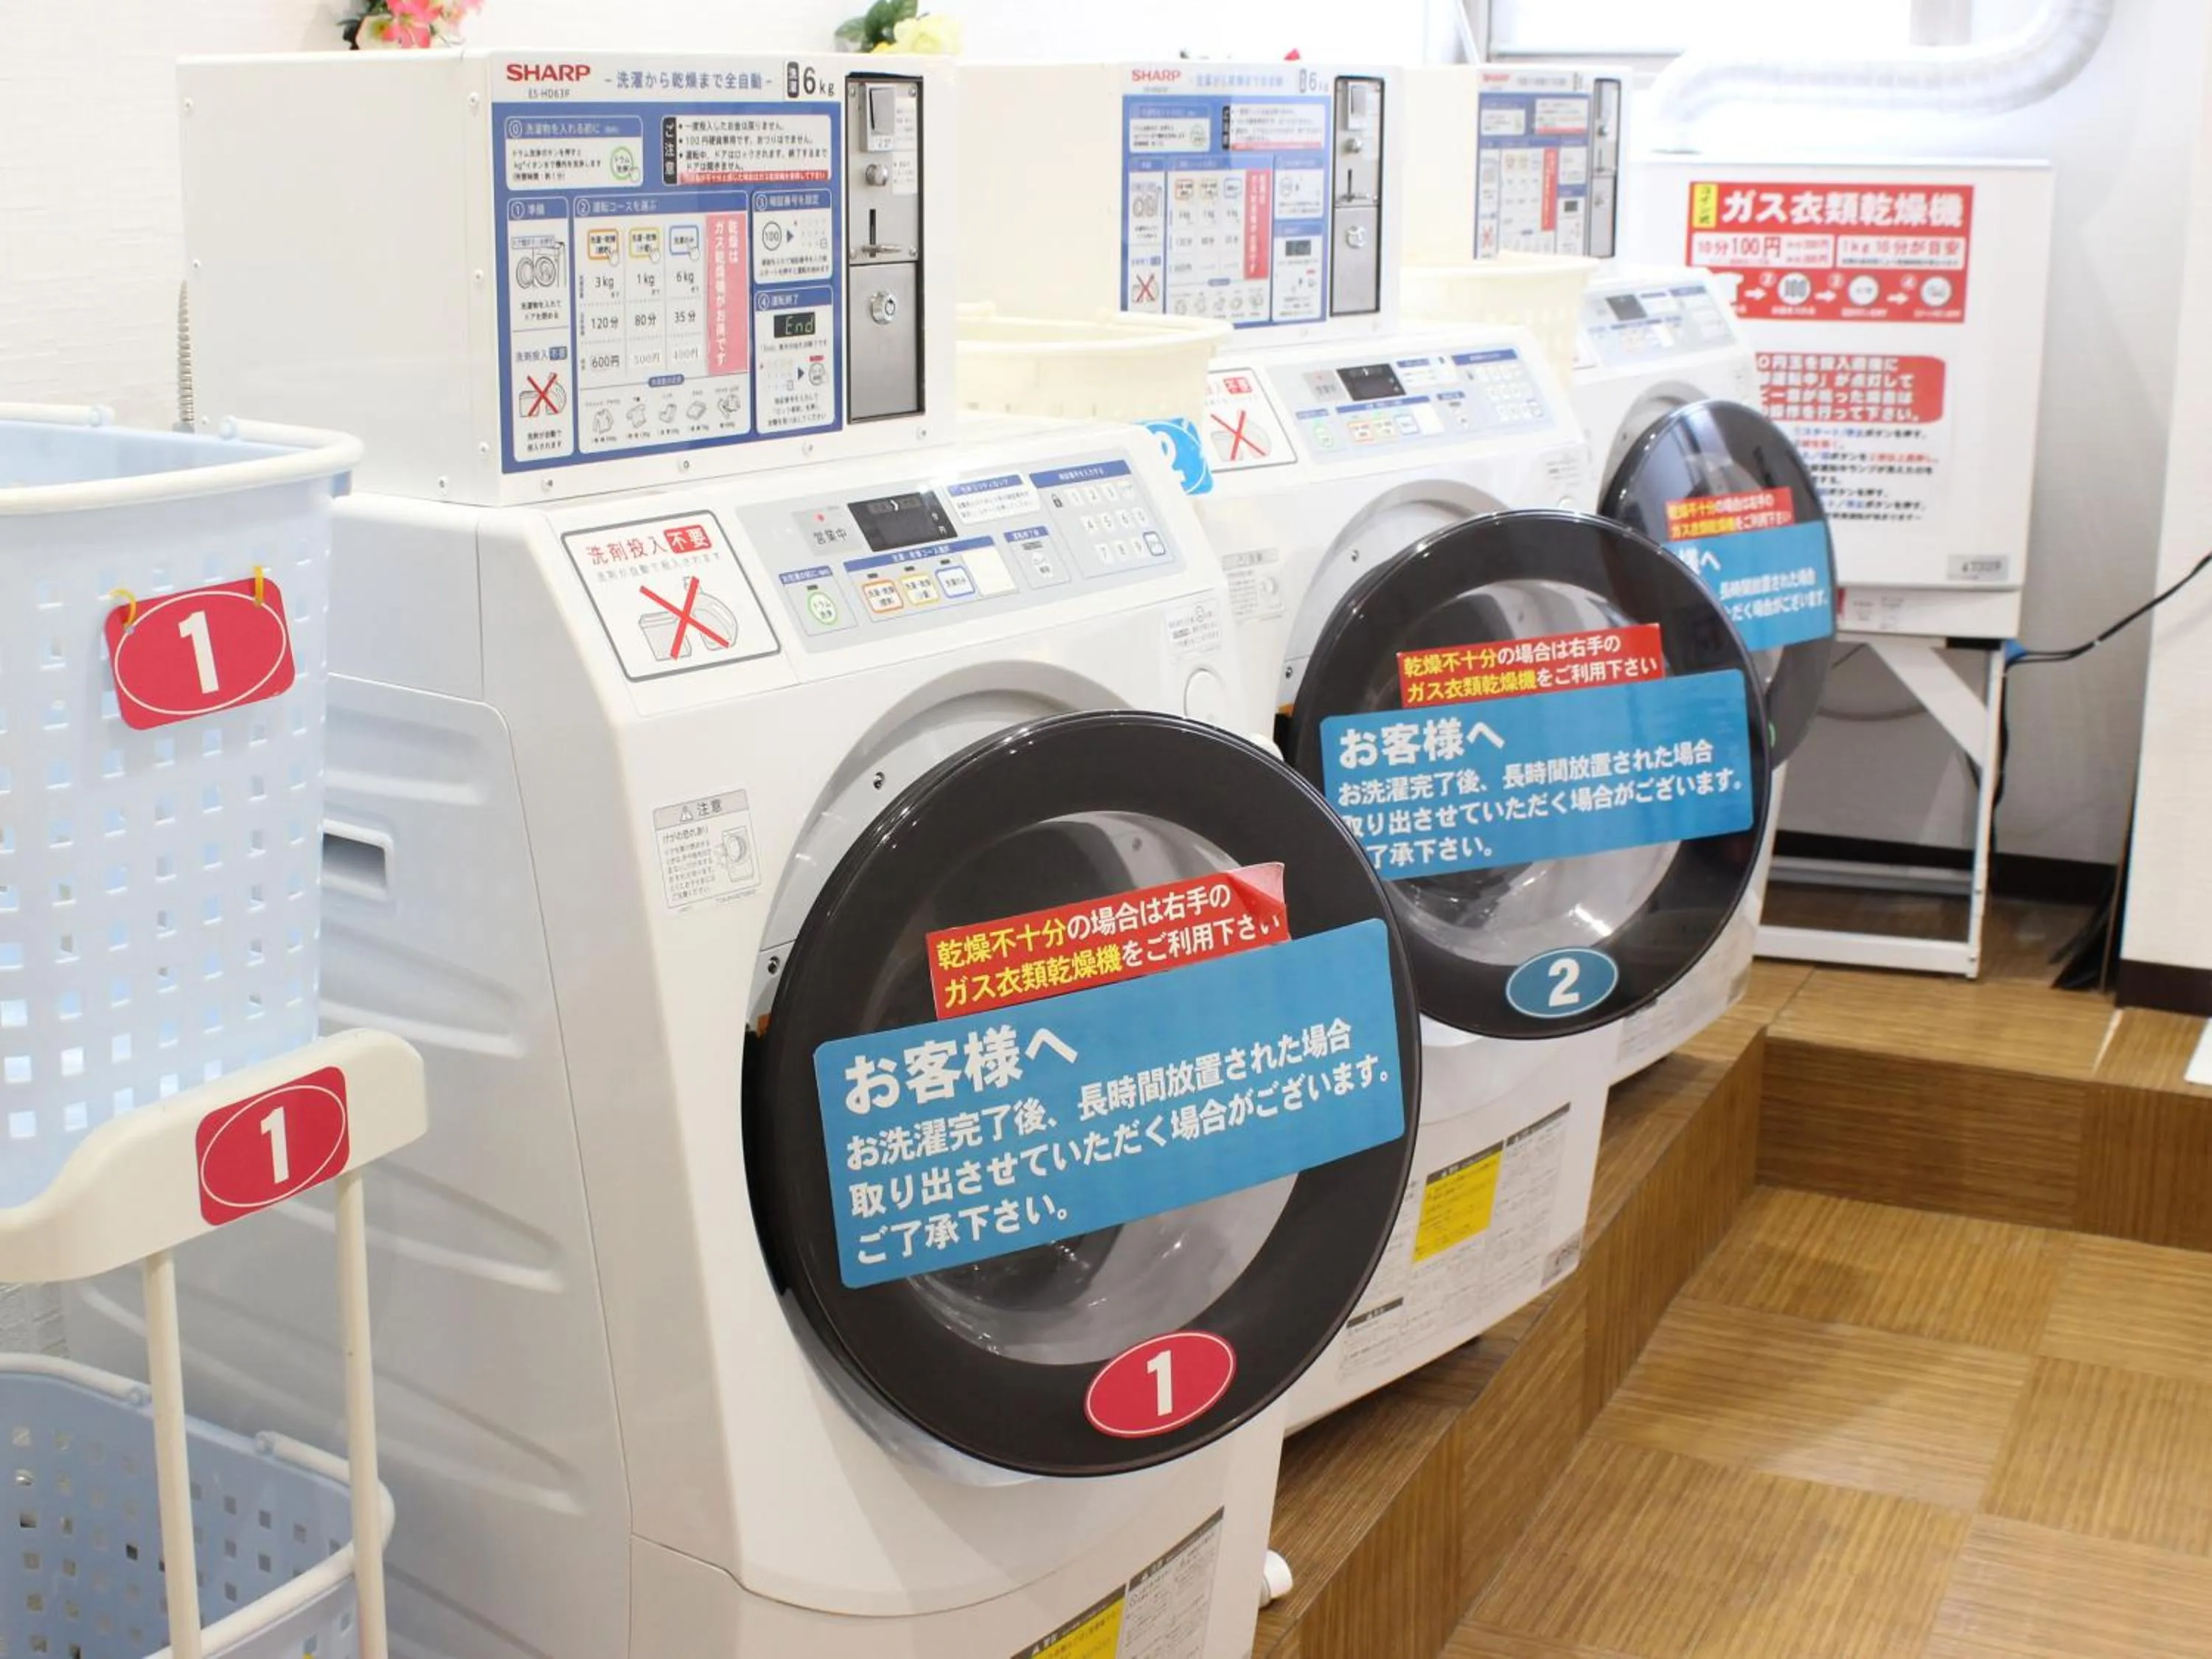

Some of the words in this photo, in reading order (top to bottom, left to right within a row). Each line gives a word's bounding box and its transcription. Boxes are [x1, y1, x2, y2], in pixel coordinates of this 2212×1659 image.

[507, 64, 591, 82] SHARP
[804, 67, 835, 96] 6kg
[1131, 70, 1181, 83] SHARP
[1722, 189, 1964, 229] ガス衣類乾燥機
[595, 276, 614, 290] 3kg
[637, 273, 655, 287] 1kg
[676, 271, 695, 285] 6kg
[591, 316, 619, 330] 120分
[635, 313, 656, 327] 80分
[674, 310, 695, 324] 35分
[785, 316, 813, 335] End
[592, 354, 619, 368] 600円
[586, 528, 709, 566] 洗剤投入不要
[813, 528, 848, 545] 営業中
[178, 611, 219, 694] 1
[1403, 635, 1621, 678] 乾燥不十分の場合は右手の
[1407, 656, 1658, 703] ガス衣類乾燥機をご利用下さい
[1338, 717, 1505, 770] お客様へ
[1338, 739, 1714, 807] お洗濯完了後、長時間放置された場合
[1341, 768, 1742, 838] 取り出させていただく場合がございます。
[1365, 837, 1492, 870] 了承下さい。
[936, 883, 1231, 971] 乾燥不十分の場合は右手の
[944, 913, 1281, 1009] ガス衣類乾燥機をご利用下さい
[1548, 958, 1580, 1006] 2
[844, 1024, 1078, 1115] お客様へ
[846, 1018, 1352, 1171] お洗濯完了後、長時間放置された場合
[260, 1106, 289, 1184] 1
[849, 1054, 1390, 1219] 取り出させていただく場合がございます。
[855, 1192, 1068, 1265] ご了承下さい。
[1147, 1349, 1173, 1416] 1
